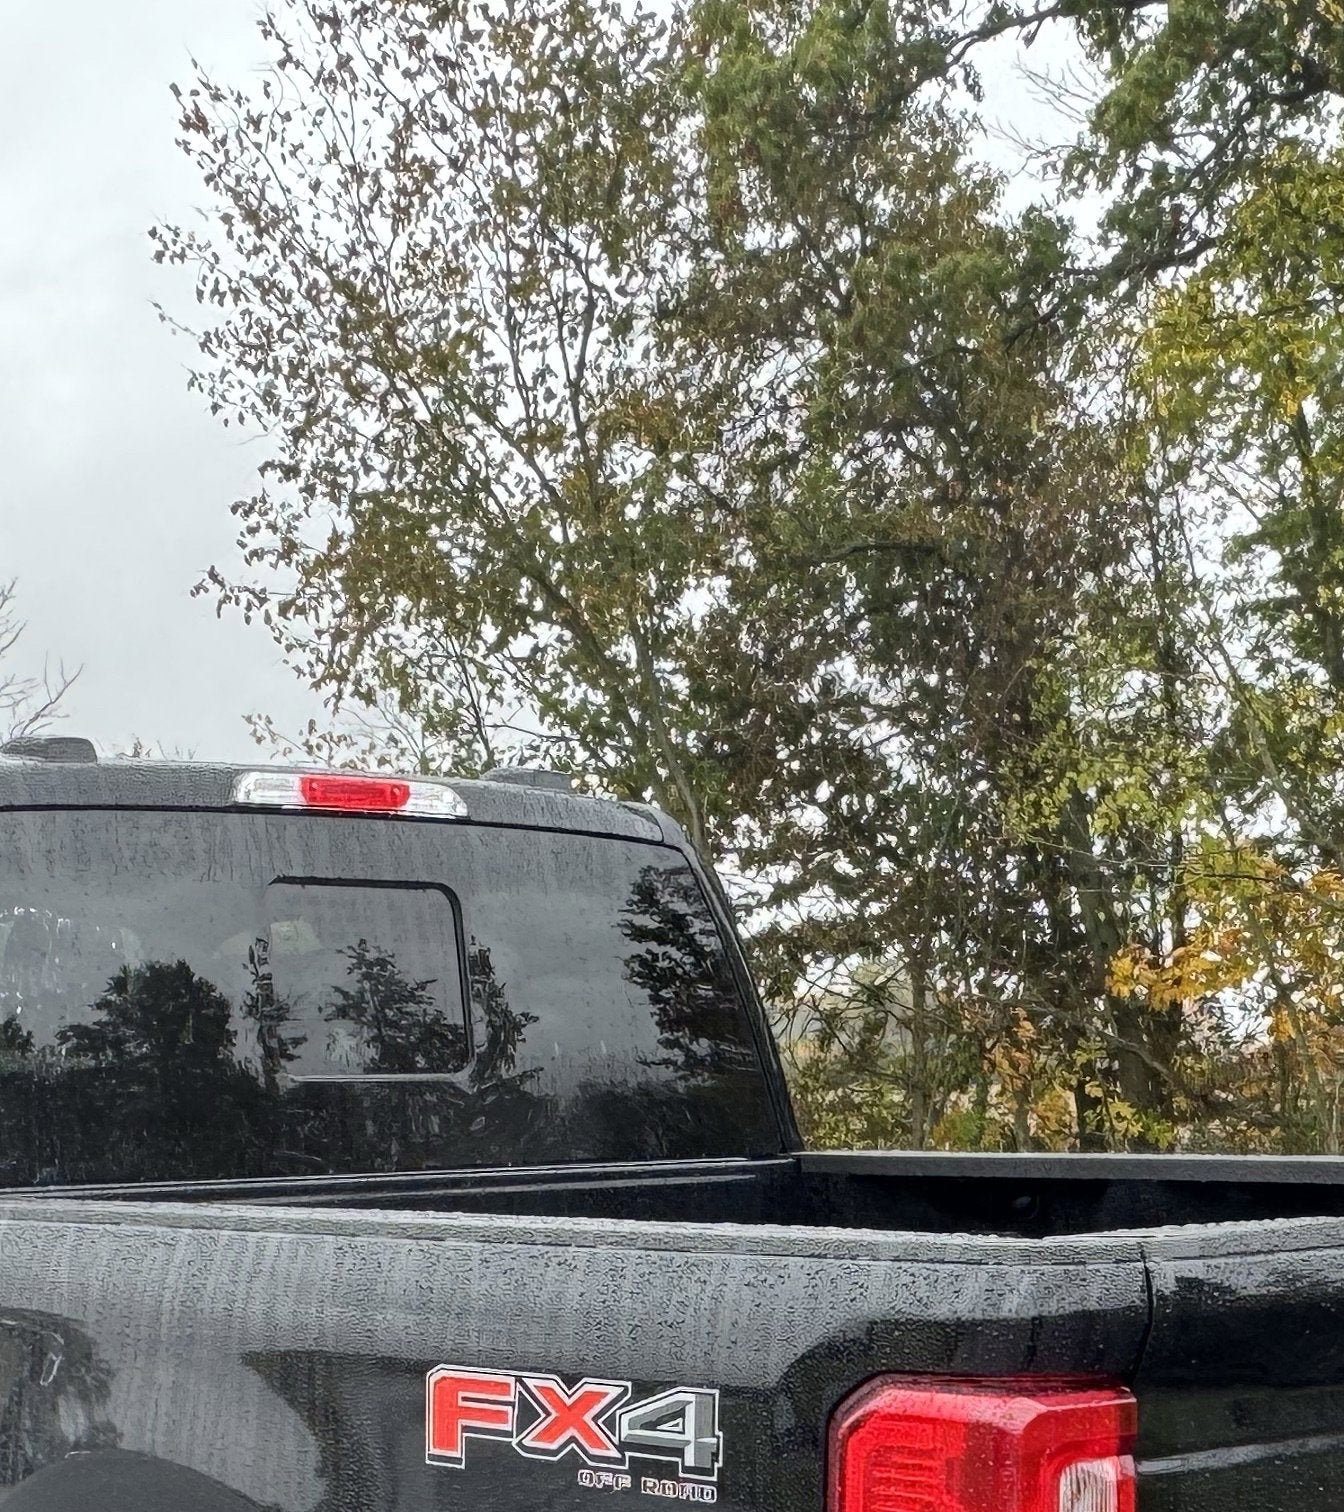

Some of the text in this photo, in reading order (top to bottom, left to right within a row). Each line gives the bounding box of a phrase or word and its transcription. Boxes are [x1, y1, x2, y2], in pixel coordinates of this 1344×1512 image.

[426, 1364, 723, 1481] FX4
[578, 1469, 718, 1503] OFF ROAD
